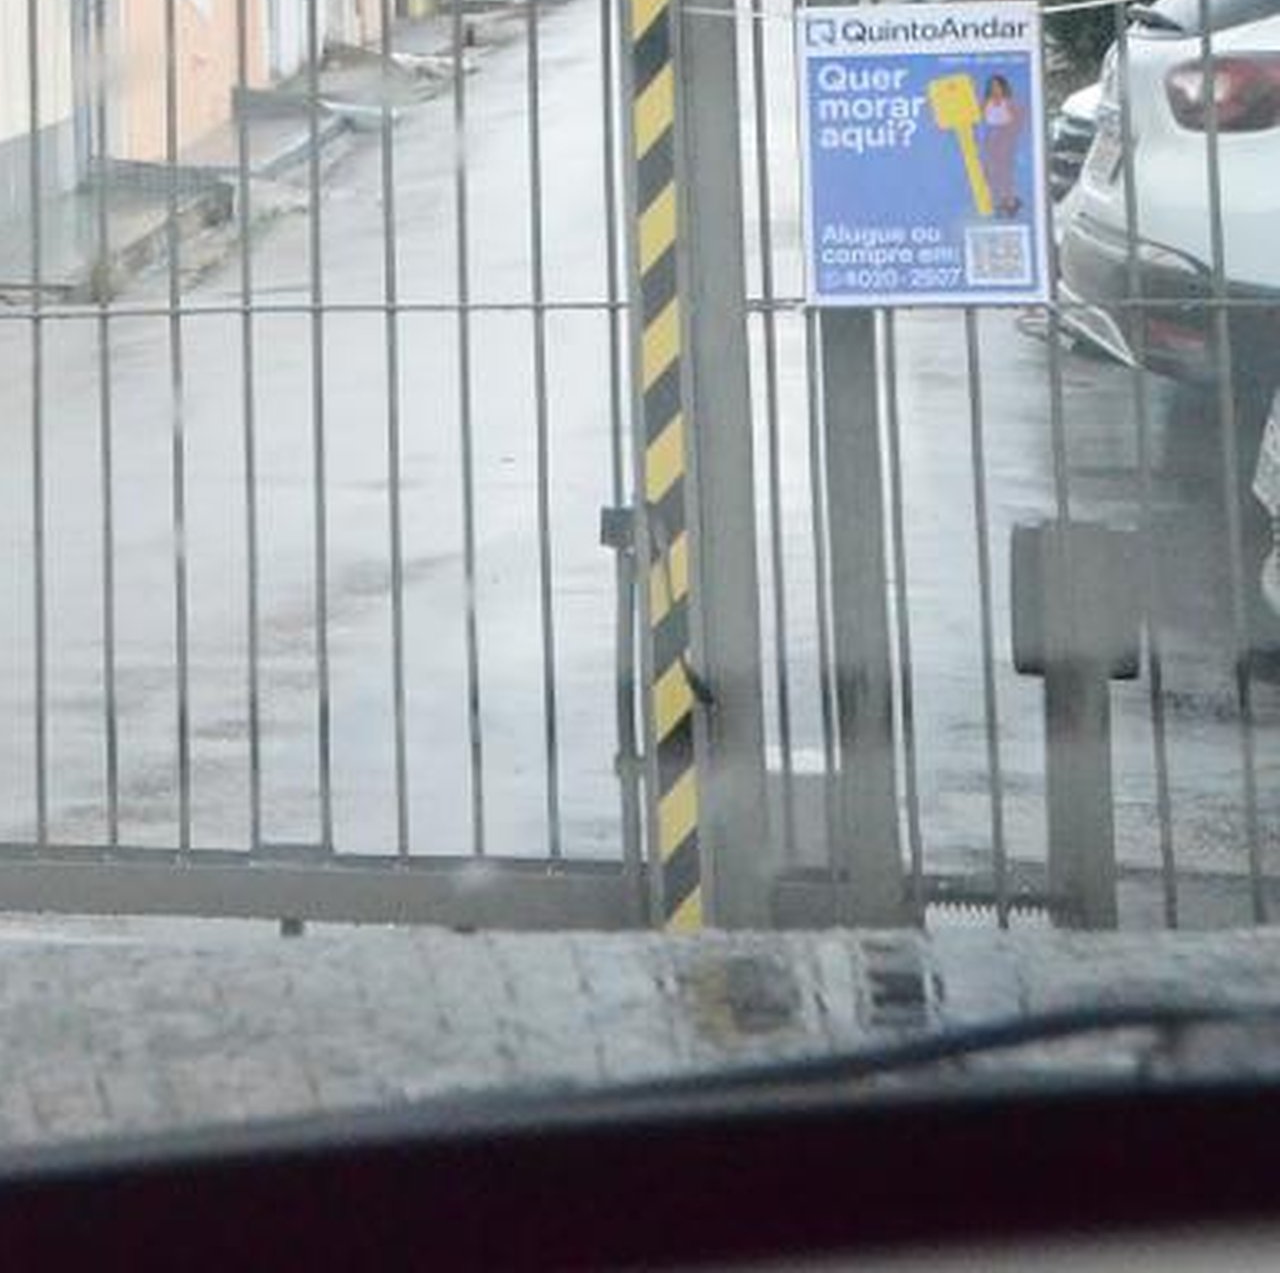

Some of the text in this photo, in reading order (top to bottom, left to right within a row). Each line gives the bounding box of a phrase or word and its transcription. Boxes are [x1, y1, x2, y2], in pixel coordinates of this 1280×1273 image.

[842, 17, 1028, 44] QuintoAndar
[818, 65, 907, 92] Quer
[818, 97, 924, 120] morar
[818, 120, 917, 153] aqui?
[822, 225, 941, 247] Alugue ou
[821, 245, 913, 269] compre
